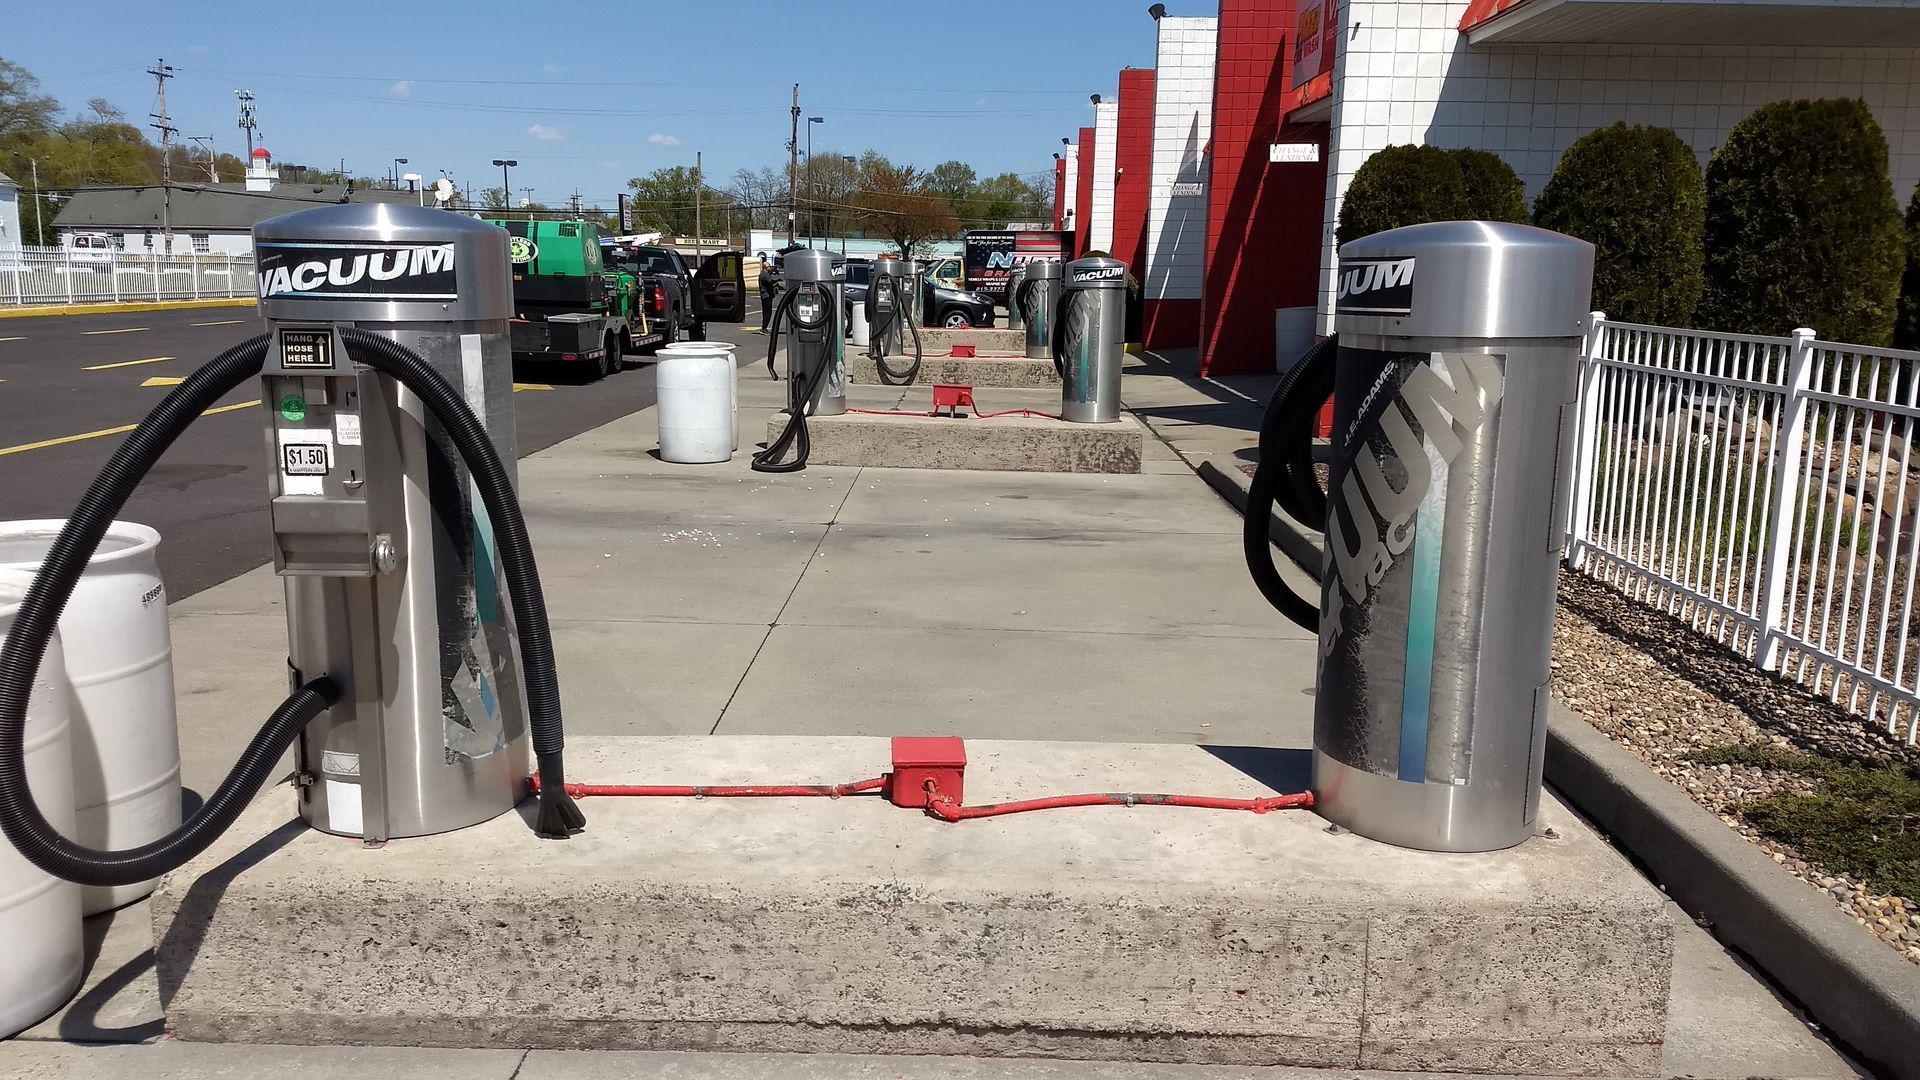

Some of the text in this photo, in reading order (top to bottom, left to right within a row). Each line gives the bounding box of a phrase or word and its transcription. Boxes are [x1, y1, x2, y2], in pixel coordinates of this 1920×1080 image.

[258, 243, 455, 299] VACUUM
[1073, 266, 1124, 282] VACUUM
[288, 448, 324, 466] $1.50
